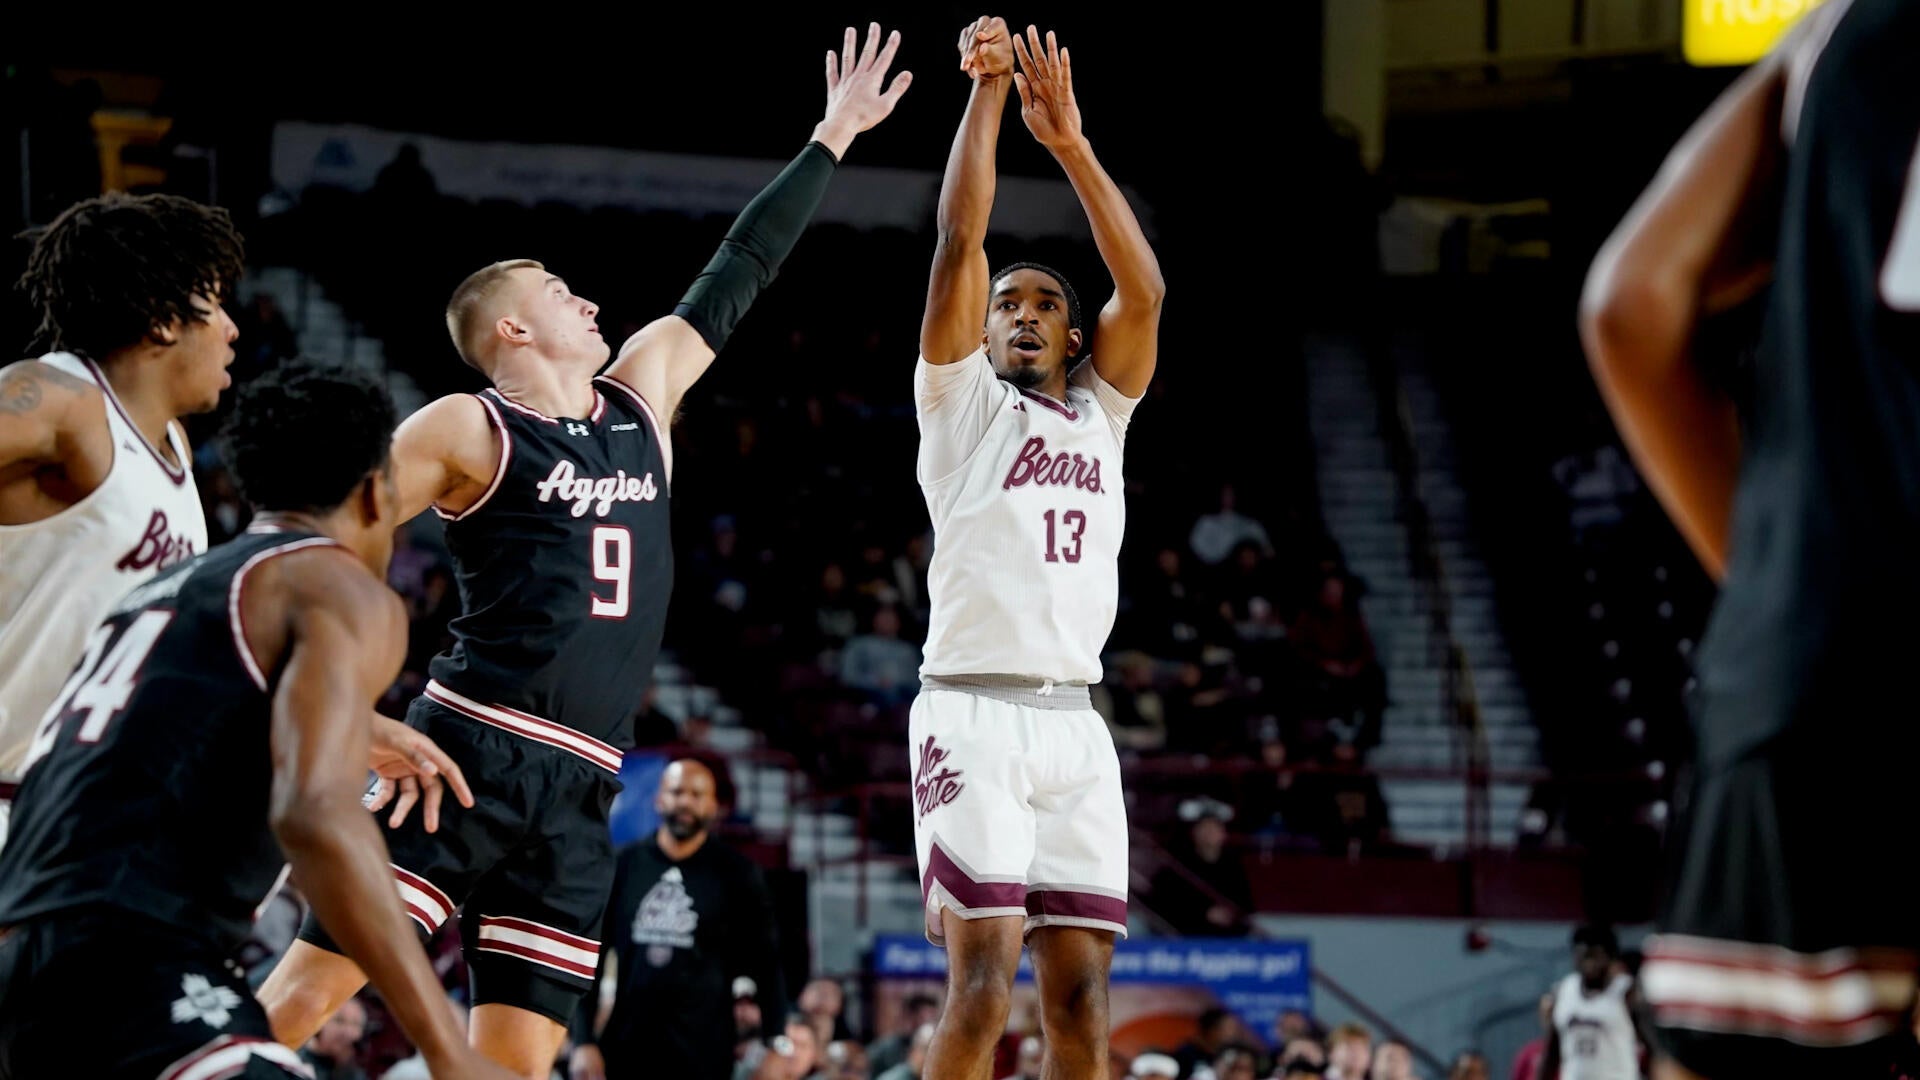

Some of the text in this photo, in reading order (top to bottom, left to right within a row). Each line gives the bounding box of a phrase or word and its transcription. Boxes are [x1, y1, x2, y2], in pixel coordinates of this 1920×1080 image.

[536, 459, 658, 518] Aggies
[1002, 435, 1105, 494] Bears
[1043, 509, 1087, 563] 13
[590, 523, 633, 620] 9
